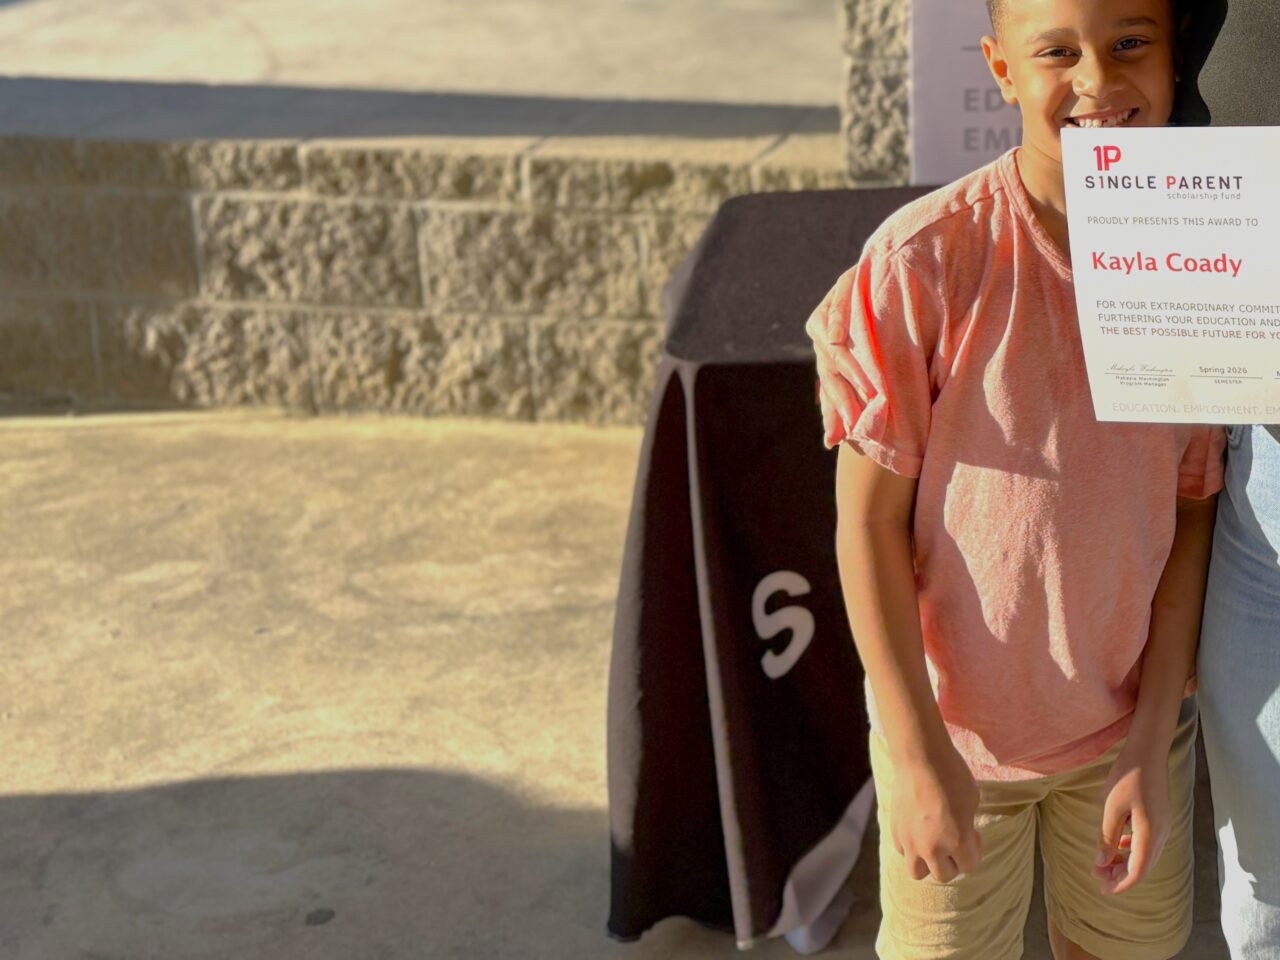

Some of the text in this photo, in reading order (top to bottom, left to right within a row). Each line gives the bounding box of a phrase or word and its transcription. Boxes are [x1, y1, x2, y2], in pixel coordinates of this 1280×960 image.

[1093, 145, 1122, 171] 1P
[1166, 176, 1243, 190] PARENT
[1167, 192, 1241, 201] scholarship fund
[1087, 216, 1259, 227] PROUDLY PRESENTS THIS AWARD TO
[1092, 251, 1243, 277] Kayla Coady
[1096, 300, 1117, 310] FOR
[1119, 301, 1148, 310] YOUR
[1150, 301, 1235, 313] EXTRAORDINARY
[1098, 313, 1162, 324] FURTHERING
[1165, 315, 1194, 325] YOUR
[1196, 316, 1256, 327] EDUCATION
[1100, 326, 1120, 335] THE
[1122, 326, 1147, 336] BEST
[1151, 327, 1199, 338] POSSIBLE
[1202, 329, 1242, 339] FUTURE
[1245, 330, 1266, 340] FOR
[1199, 365, 1248, 375] Spring 2026
